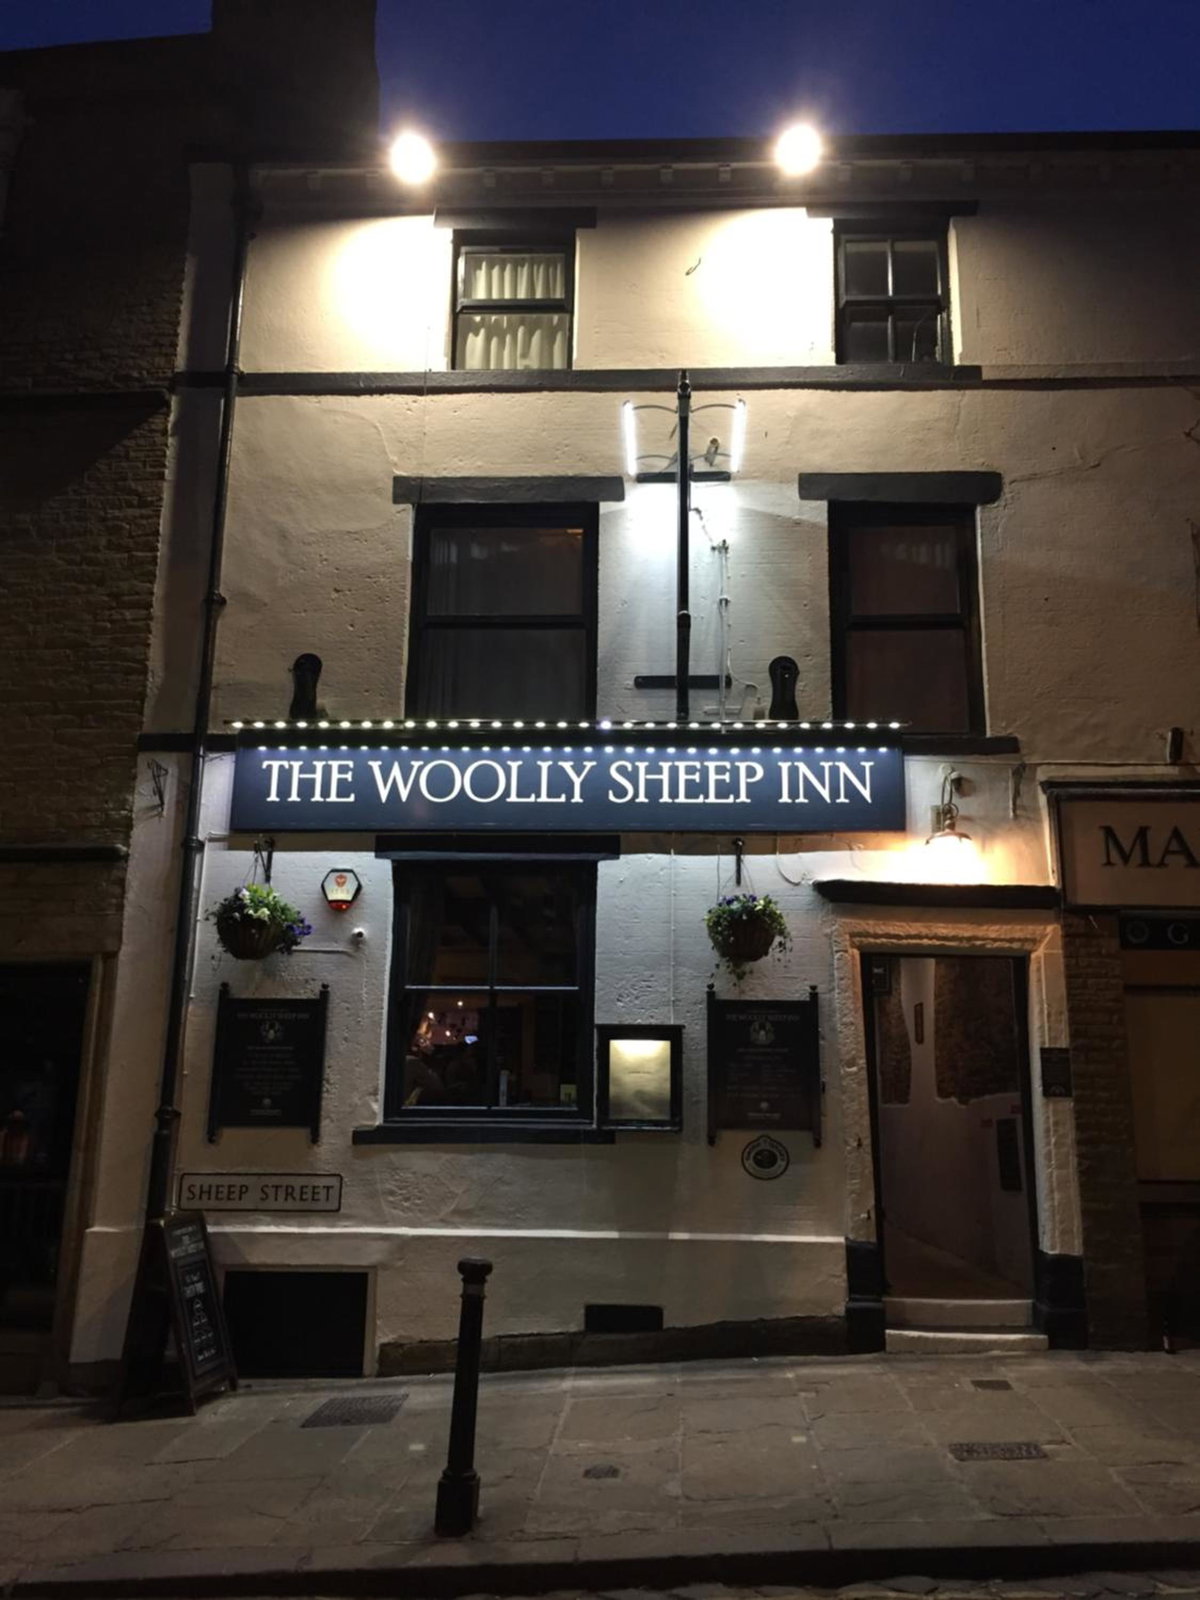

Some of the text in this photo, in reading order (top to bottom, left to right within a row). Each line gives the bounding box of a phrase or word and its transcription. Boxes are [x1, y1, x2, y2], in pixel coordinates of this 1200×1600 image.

[261, 758, 875, 804] THE WOOLLY SHEEP INN
[186, 1184, 334, 1203] SHEEP STREET
